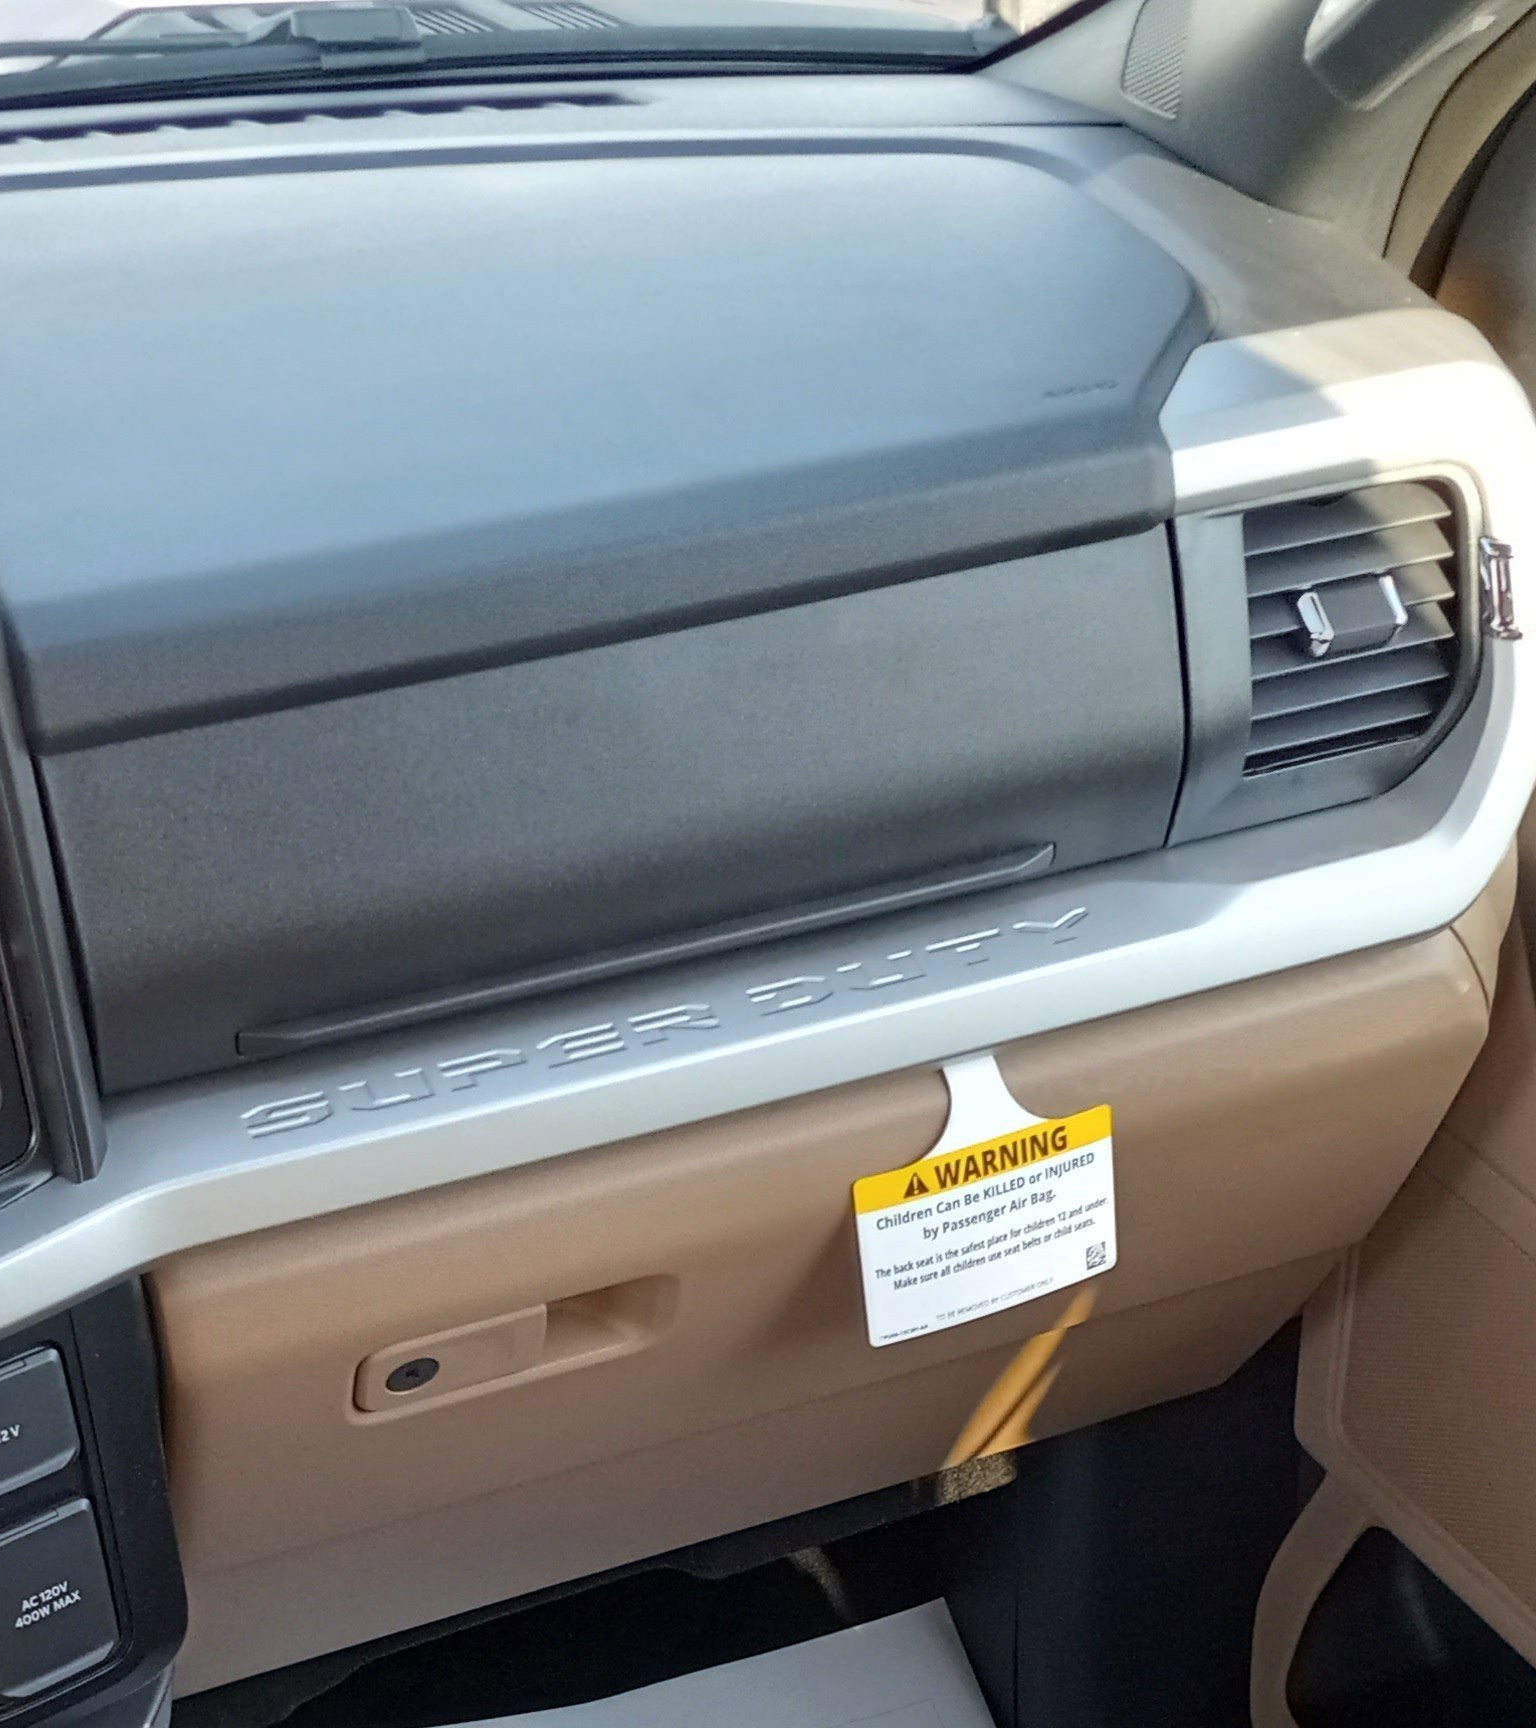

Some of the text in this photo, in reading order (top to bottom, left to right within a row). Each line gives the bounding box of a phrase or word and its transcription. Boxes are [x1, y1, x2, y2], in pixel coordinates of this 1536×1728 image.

[241, 906, 1090, 1139] SUPER DUTY
[934, 1125, 1069, 1189] WARNING
[876, 1152, 1095, 1231] Children Can Be KILLED or INJURED
[923, 1189, 1057, 1241] by Passenger Air Bag.
[875, 1197, 1109, 1280] The back seat is the safest place for children 12 and under.
[893, 1218, 1096, 1291] Make sure all children use seat belts or child seats.
[15, 1589, 82, 1629] 400W MAX
[21, 1581, 68, 1612] AC 120V
